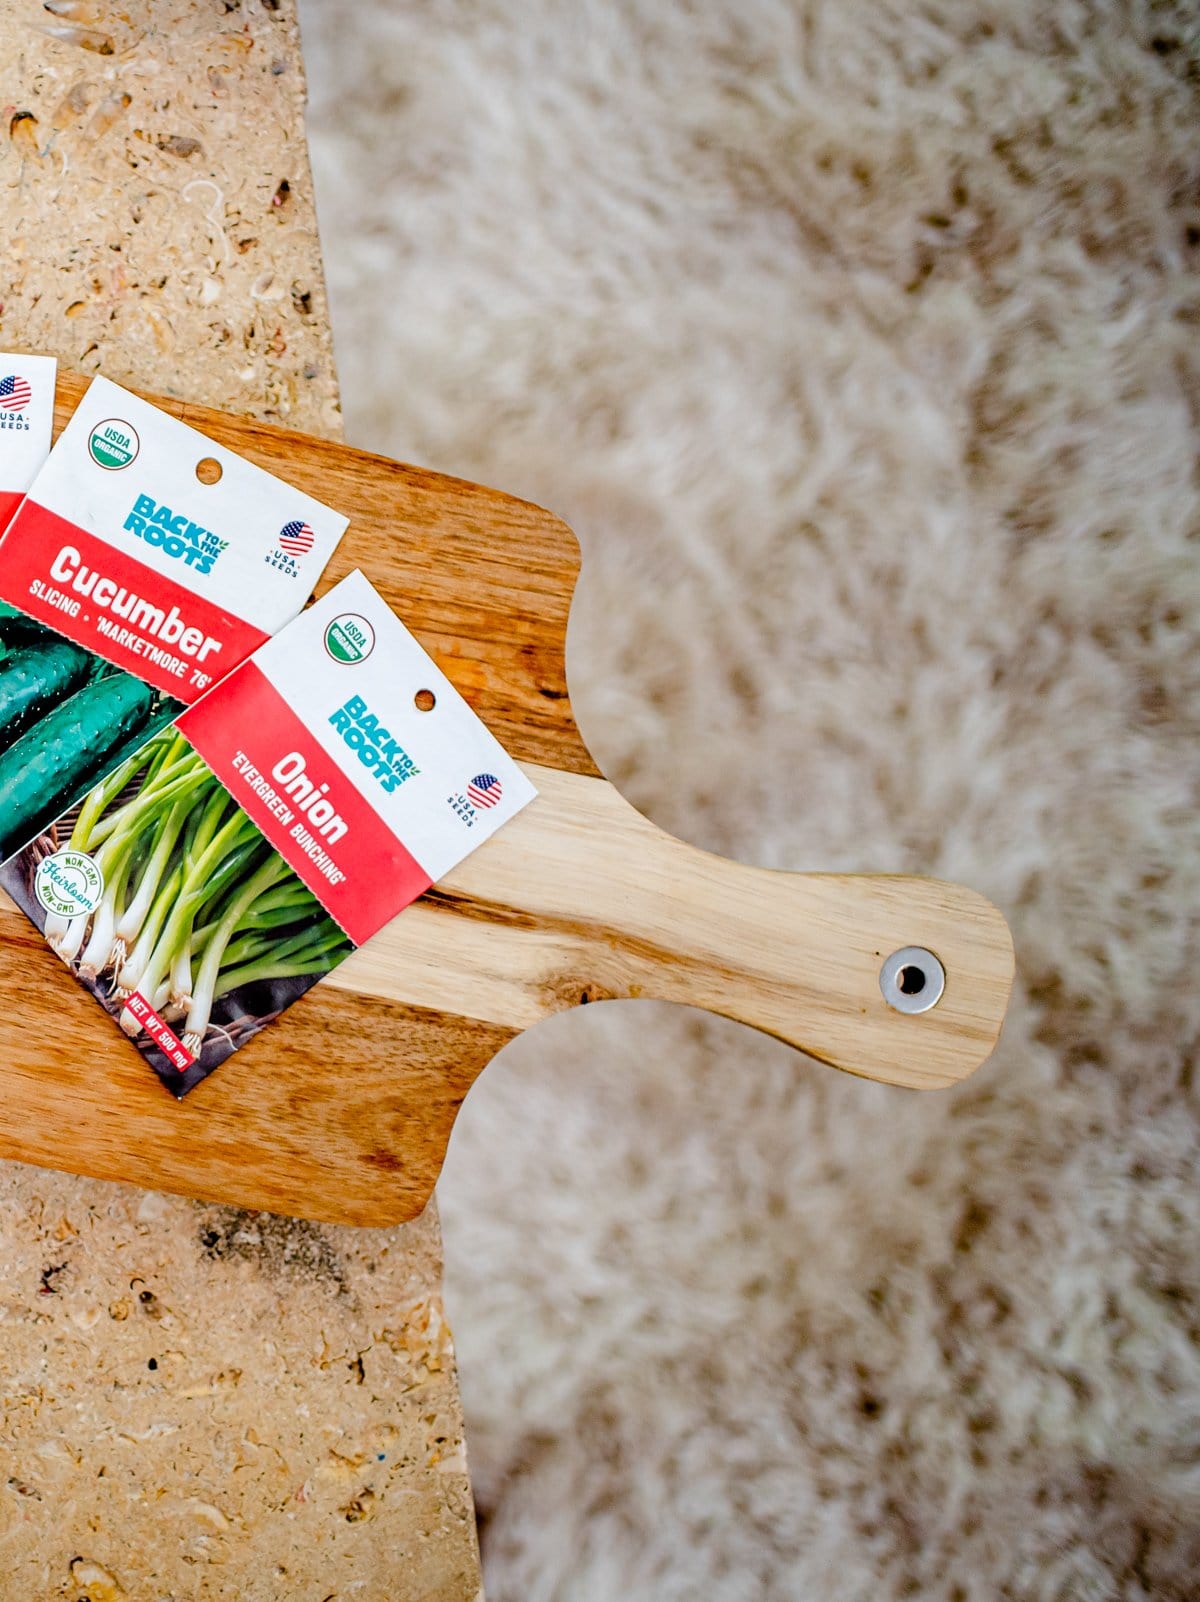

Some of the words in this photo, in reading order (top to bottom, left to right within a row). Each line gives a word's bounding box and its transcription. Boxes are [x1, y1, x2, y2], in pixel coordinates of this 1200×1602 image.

[0, 412, 24, 421] USA
[94, 438, 128, 462] ORGANIC
[104, 427, 130, 449] USDA
[132, 493, 206, 548] BACK
[123, 511, 216, 574] ROOTS
[200, 541, 221, 559] THE
[205, 532, 220, 546] TO
[265, 556, 298, 578] SEEDS
[274, 550, 295, 567] USA
[50, 546, 222, 662] Cucumber
[29, 579, 82, 617] SLICING
[97, 615, 189, 678] 'MARKETMORE
[344, 620, 367, 648] USDA
[343, 695, 404, 765] BACK
[328, 708, 402, 793] ROOTS
[400, 753, 414, 769] TO
[392, 760, 411, 782] THE
[272, 751, 349, 845] Onion
[447, 797, 473, 827] SEEDS
[458, 795, 475, 817] USA
[232, 750, 295, 827] 'EVERGREEN
[289, 822, 347, 886] BUNCHING'
[42, 860, 93, 910] Heirloom
[65, 857, 98, 886] NON-GMO
[42, 885, 74, 914] NON-GMO
[128, 996, 150, 1017] NET
[145, 1015, 163, 1033] WT
[158, 1031, 177, 1051] 500
[173, 1051, 188, 1068] mg
